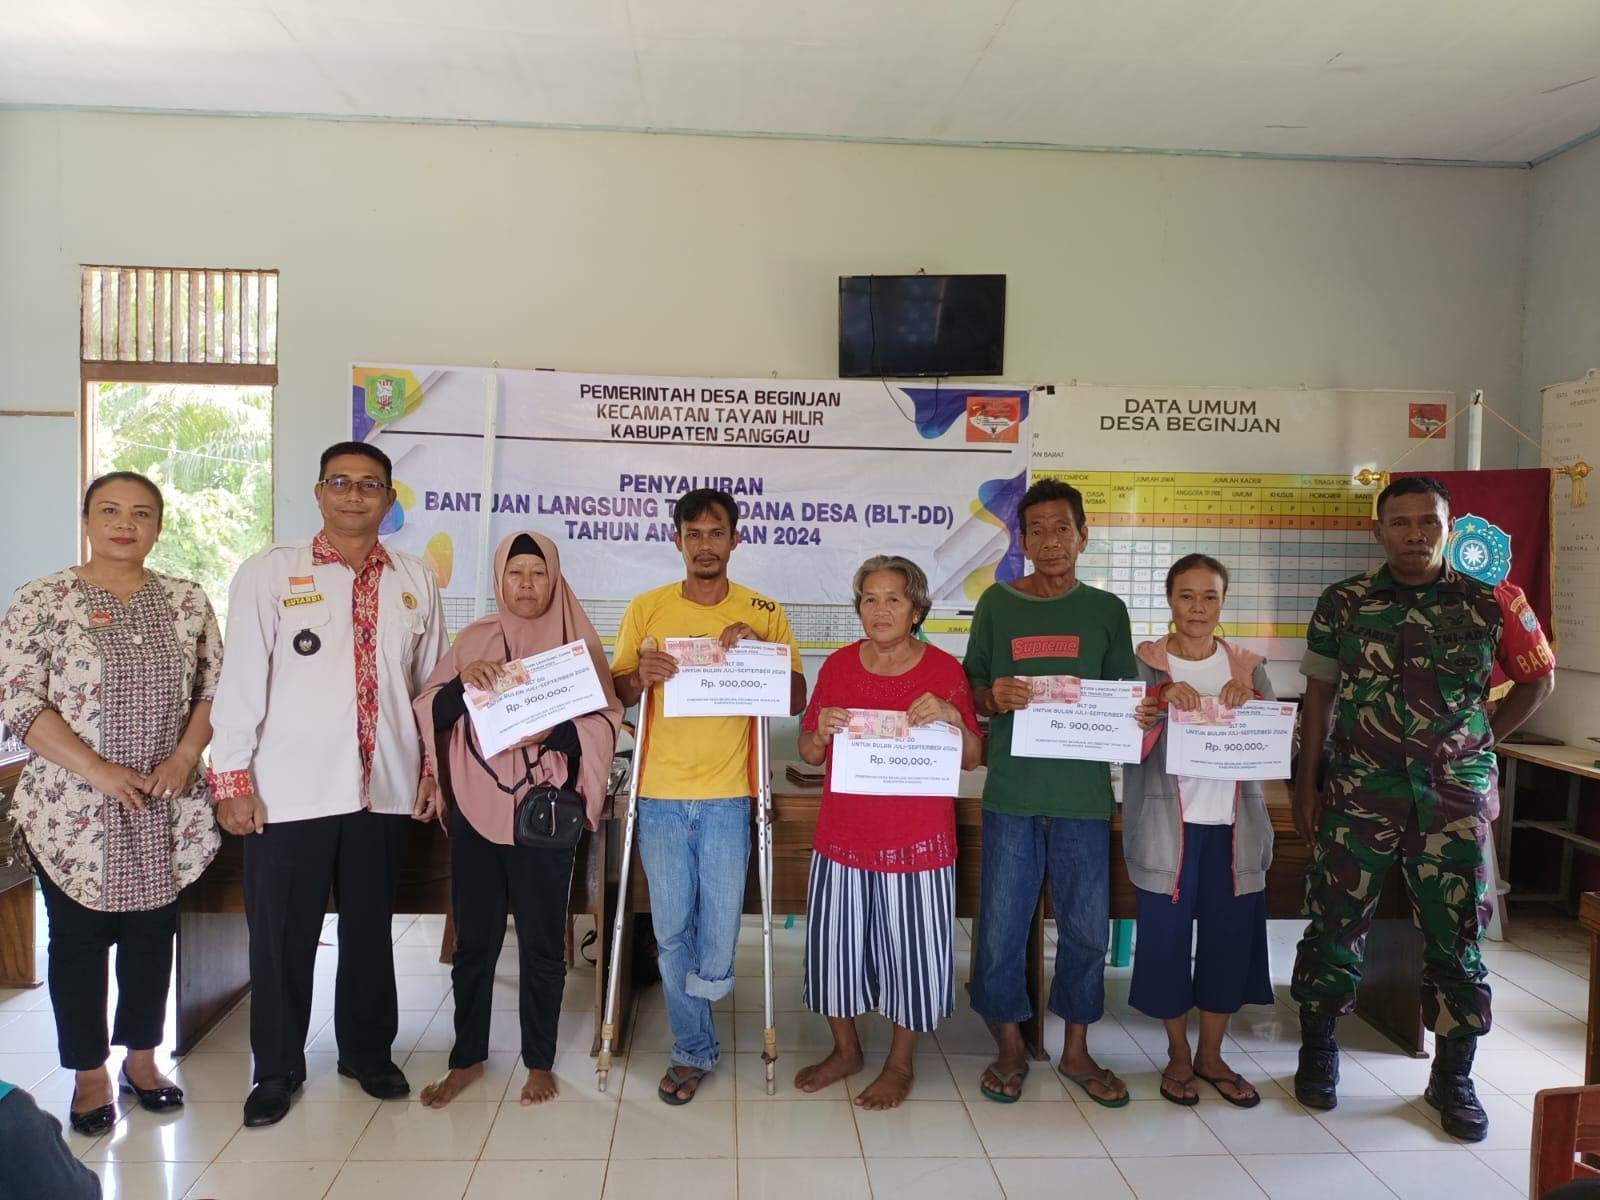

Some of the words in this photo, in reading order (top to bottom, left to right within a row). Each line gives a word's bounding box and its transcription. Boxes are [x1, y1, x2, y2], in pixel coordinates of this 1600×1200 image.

[580, 384, 696, 404] PEMERINTAH
[701, 389, 749, 405] DESA
[754, 391, 841, 407] BEGINJAN
[596, 404, 710, 424] KECAMATAN
[718, 408, 777, 426] TAYAN
[782, 411, 824, 427] HILIR
[1125, 398, 1181, 415] DATA
[1188, 399, 1257, 416] UMUM
[1100, 415, 1159, 432] DESA
[1165, 417, 1281, 434] BEGINJAN
[610, 425, 718, 442] KABUPATEN
[727, 428, 810, 445] SANGGAU
[1044, 451, 1065, 459] BARAT
[620, 474, 763, 496] PENYALURAN
[537, 495, 658, 518] LANGSUNG
[801, 503, 858, 523] DESA
[864, 505, 954, 530] (BLT-DD)
[564, 520, 639, 542] TAHUN
[773, 527, 823, 546] 2024
[751, 597, 776, 612] T90
[1014, 640, 1077, 657] Supreme
[700, 679, 716, 689] Rp.
[506, 703, 522, 714] Rp.
[1050, 720, 1067, 731] Rp.
[1205, 742, 1222, 753] Rp.
[870, 755, 887, 766] Rp.
